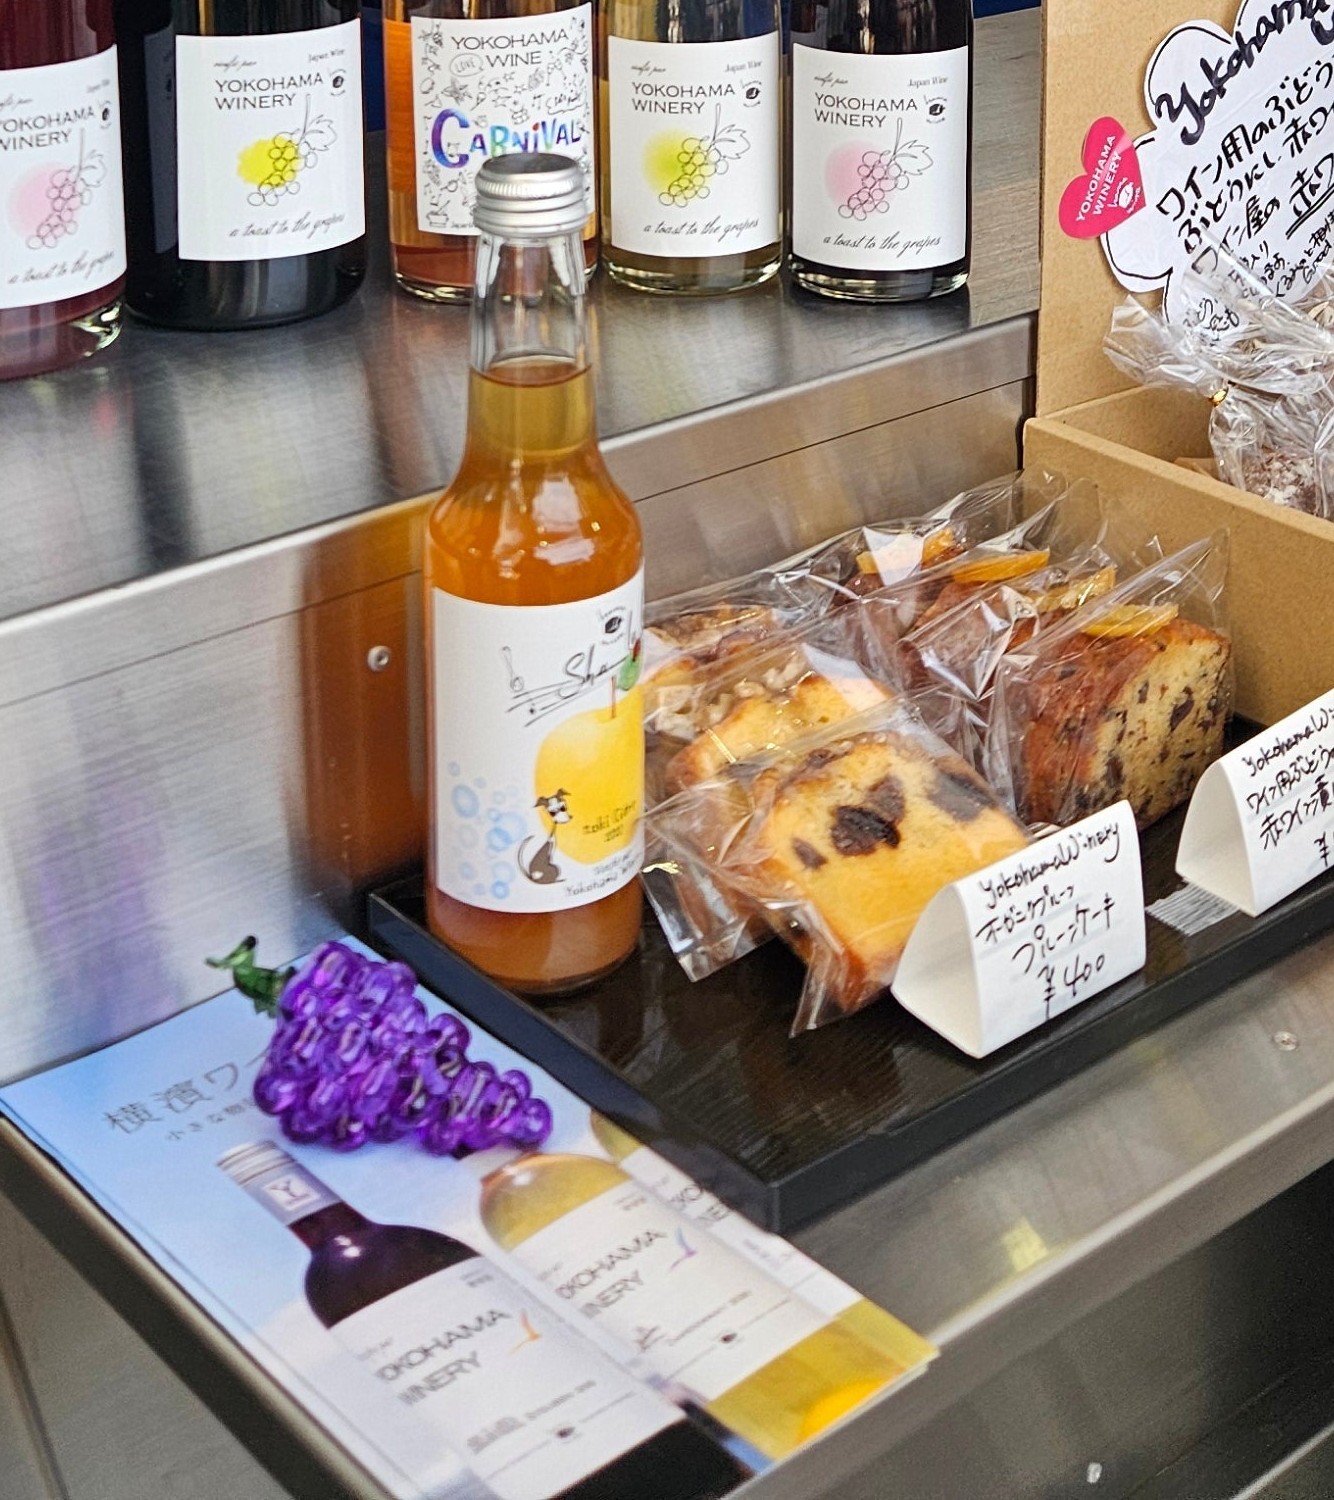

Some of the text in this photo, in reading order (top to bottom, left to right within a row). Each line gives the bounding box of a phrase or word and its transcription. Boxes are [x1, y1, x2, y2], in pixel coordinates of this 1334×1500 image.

[451, 28, 568, 51] YOKOHAMA
[486, 51, 542, 68] WINE
[215, 72, 324, 93] YOKOHAMA
[631, 81, 736, 98] YOKOHAMA
[215, 93, 297, 110] WINERY
[631, 98, 705, 114] WINERY
[815, 92, 918, 112] YOKOHAMA
[814, 108, 886, 128] WINERY
[1076, 134, 1116, 221] YOKOHAMA
[1093, 150, 1122, 215] WINERY
[242, 222, 275, 236] toast
[292, 210, 314, 231] the
[655, 222, 682, 234] toast
[686, 220, 698, 233] to
[699, 214, 720, 233] the
[720, 217, 759, 242] grapes
[835, 233, 861, 248] toast
[866, 235, 878, 250] to
[879, 231, 900, 249] the
[898, 235, 942, 258] grapes
[1011, 892, 1116, 974] プルーンケーキ
[1037, 953, 1106, 1021] ¥400
